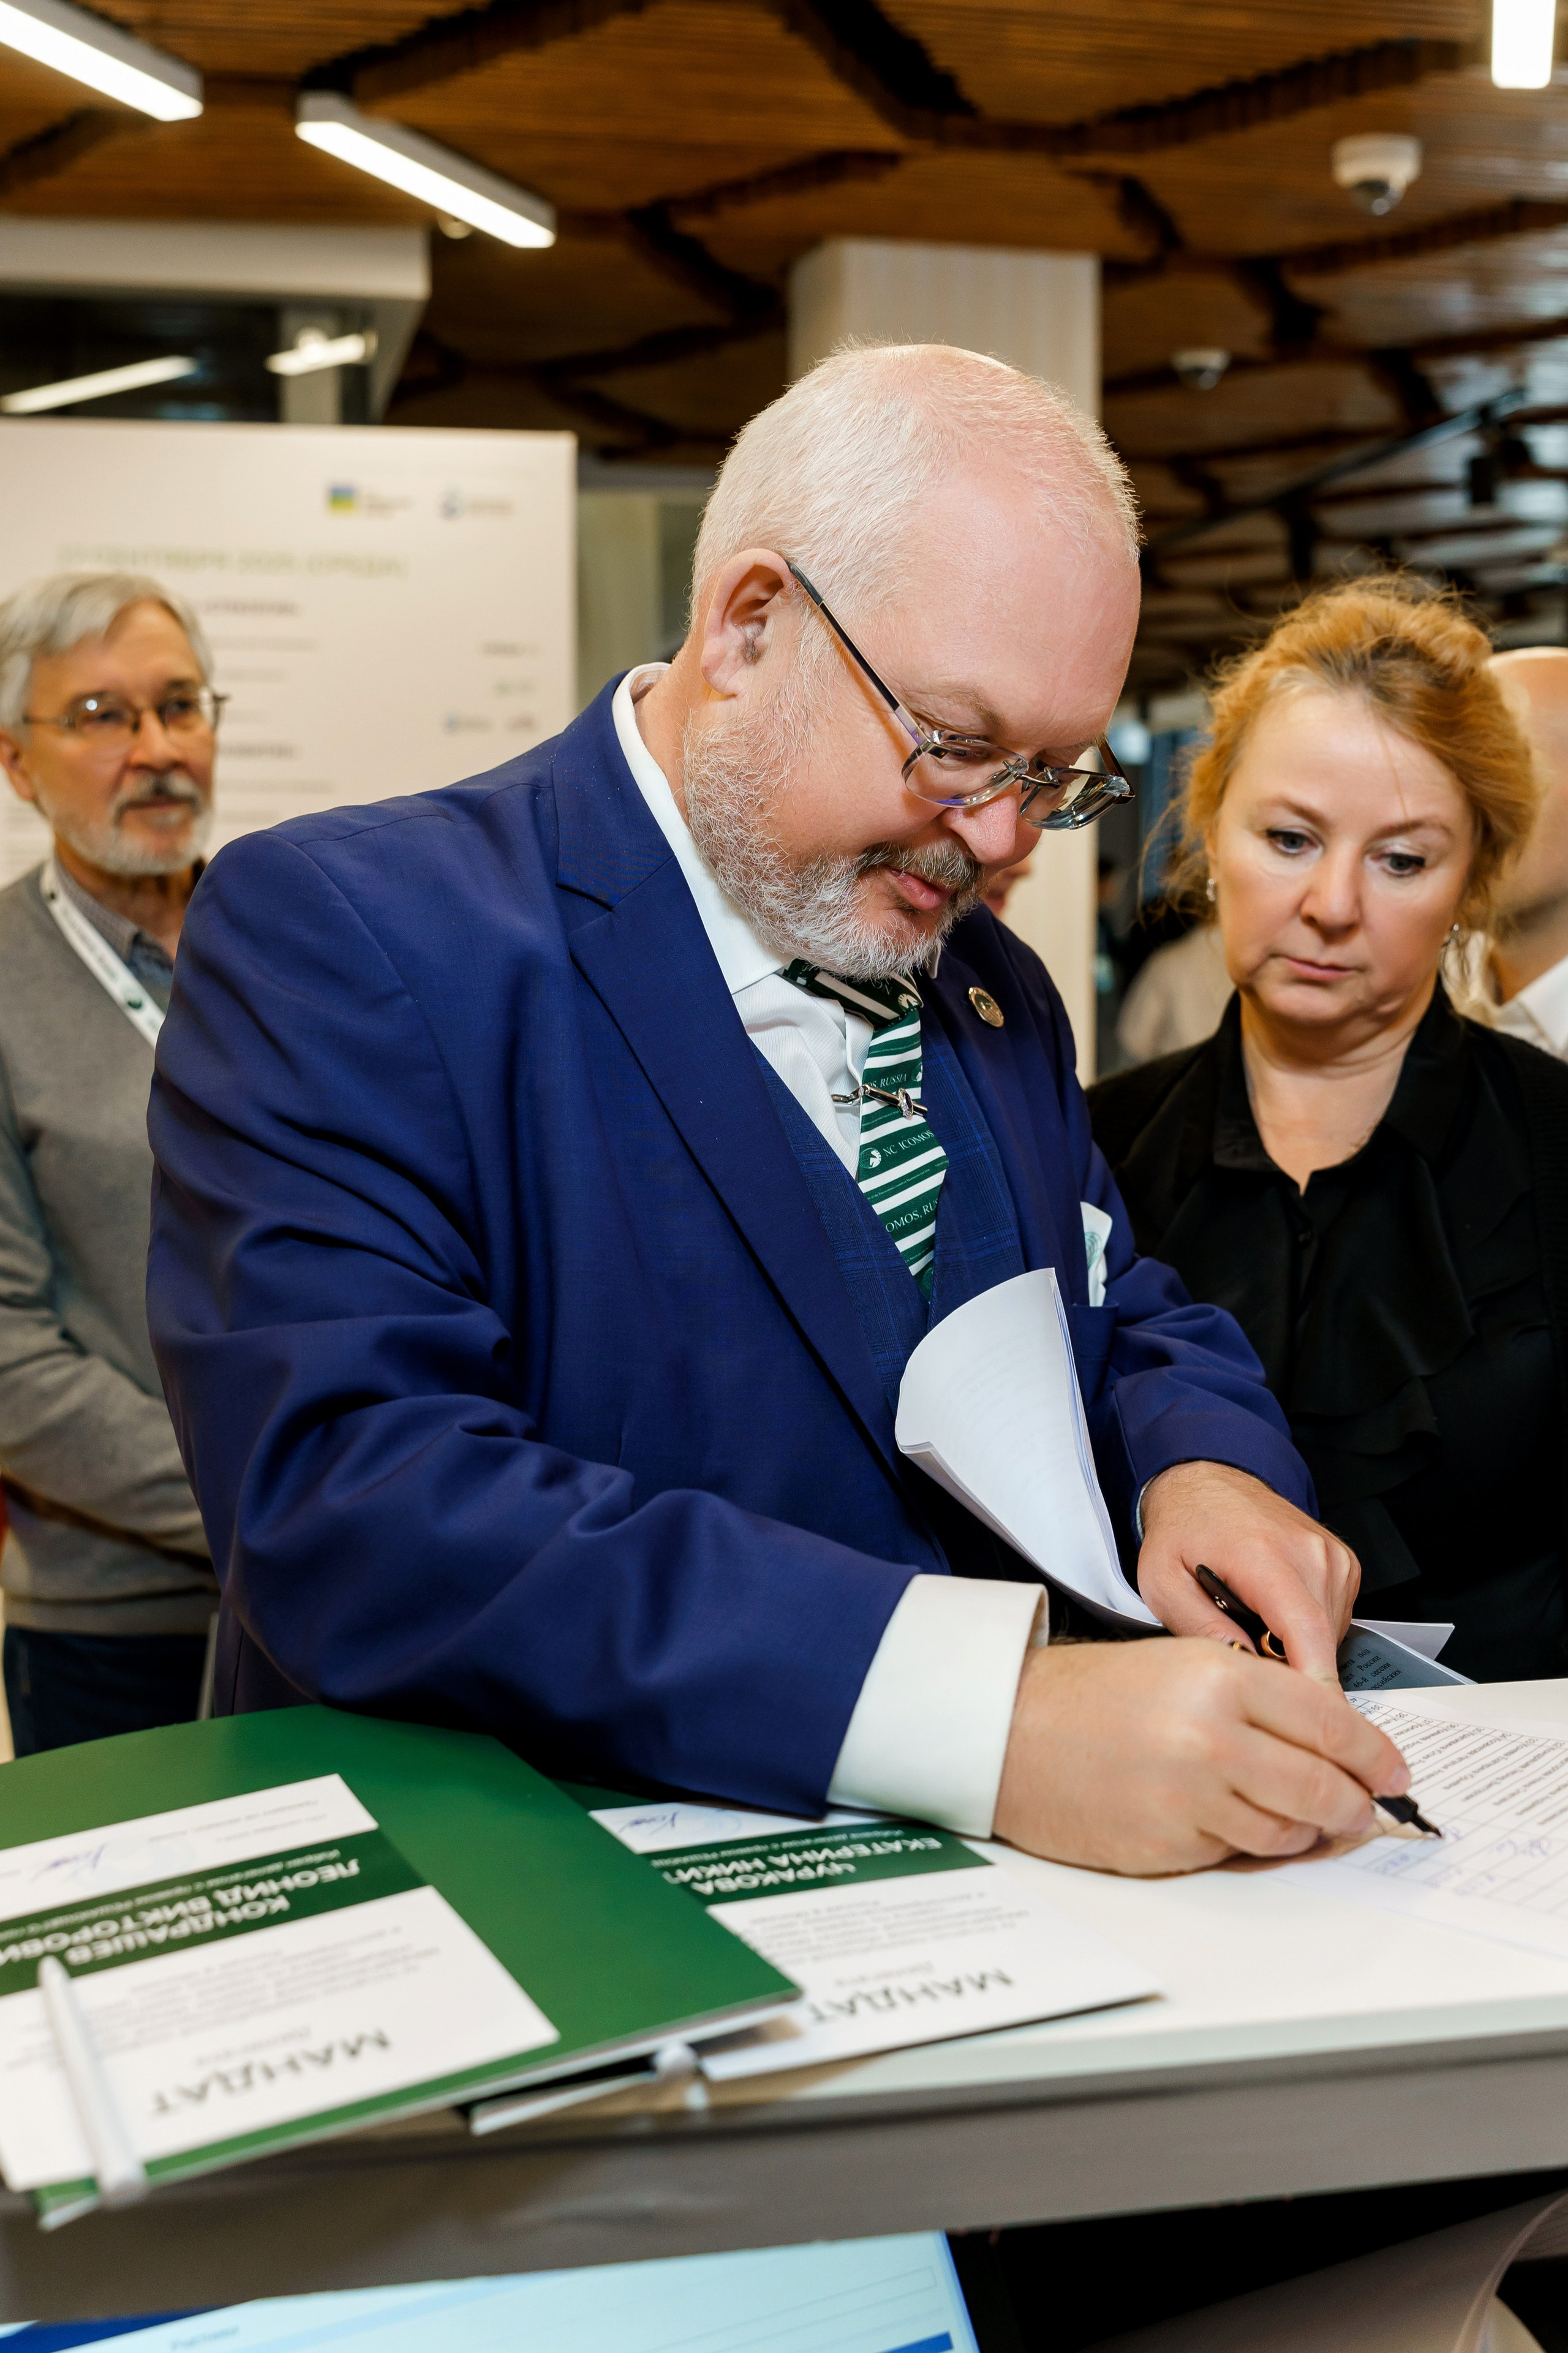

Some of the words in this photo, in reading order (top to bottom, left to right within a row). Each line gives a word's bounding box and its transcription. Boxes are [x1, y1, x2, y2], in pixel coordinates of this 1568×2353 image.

[880, 1074, 907, 1087] RUSSIA
[883, 1144, 898, 1157] NC
[898, 1130, 935, 1150] ICOMOS
[1357, 1649, 1371, 1658] под
[1357, 1655, 1381, 1671] России
[1353, 1676, 1369, 1688] 46-й
[1370, 1662, 1392, 1677] сессии
[763, 1837, 944, 1867] ЕКАТЕРИНА
[209, 1858, 361, 1908] ЛЕОНИД
[686, 1862, 858, 1895] ЧУРАКОВА
[60, 1894, 293, 1966] КОНДРАШЕВ
[807, 1970, 1014, 2024] МАНДАТ
[151, 2029, 391, 2115] МАНДАТ
